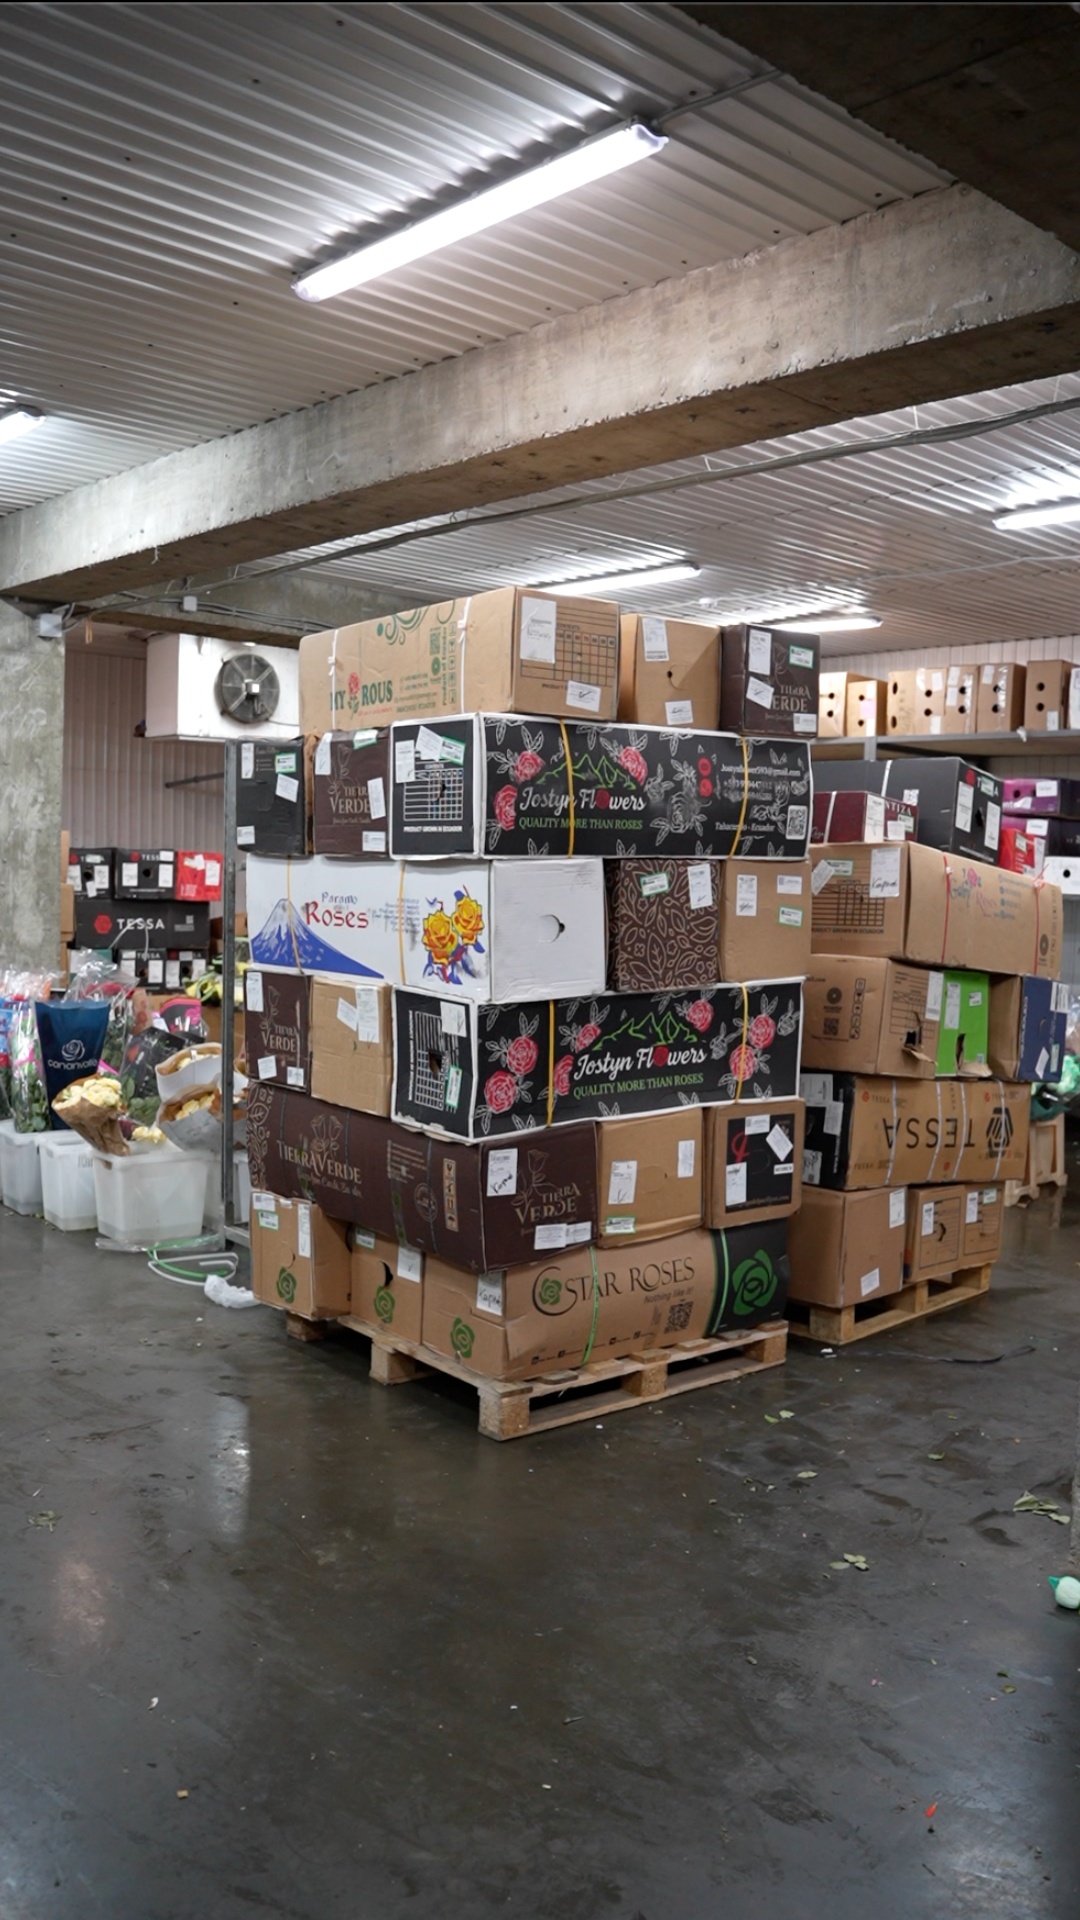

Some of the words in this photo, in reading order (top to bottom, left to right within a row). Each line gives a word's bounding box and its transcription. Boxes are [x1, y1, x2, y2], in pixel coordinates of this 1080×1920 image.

[361, 680, 393, 707] ROUS
[772, 696, 808, 713] ERDE
[329, 796, 371, 814] VERDE
[519, 786, 577, 817] Jostyn
[519, 816, 559, 830] QUALITY
[589, 818, 614, 829] THAN
[615, 819, 643, 830] ROSES
[142, 853, 161, 861] TESS
[116, 918, 165, 930] TESSA
[304, 900, 369, 929] Roses
[573, 1051, 634, 1081] Jostyn
[573, 1082, 616, 1100] QUALITY
[617, 1079, 647, 1093] MORE
[647, 1076, 673, 1089] THAN
[674, 1073, 704, 1087] ROSES
[882, 1117, 976, 1149] TESSA
[629, 1256, 695, 1293] ROSES
